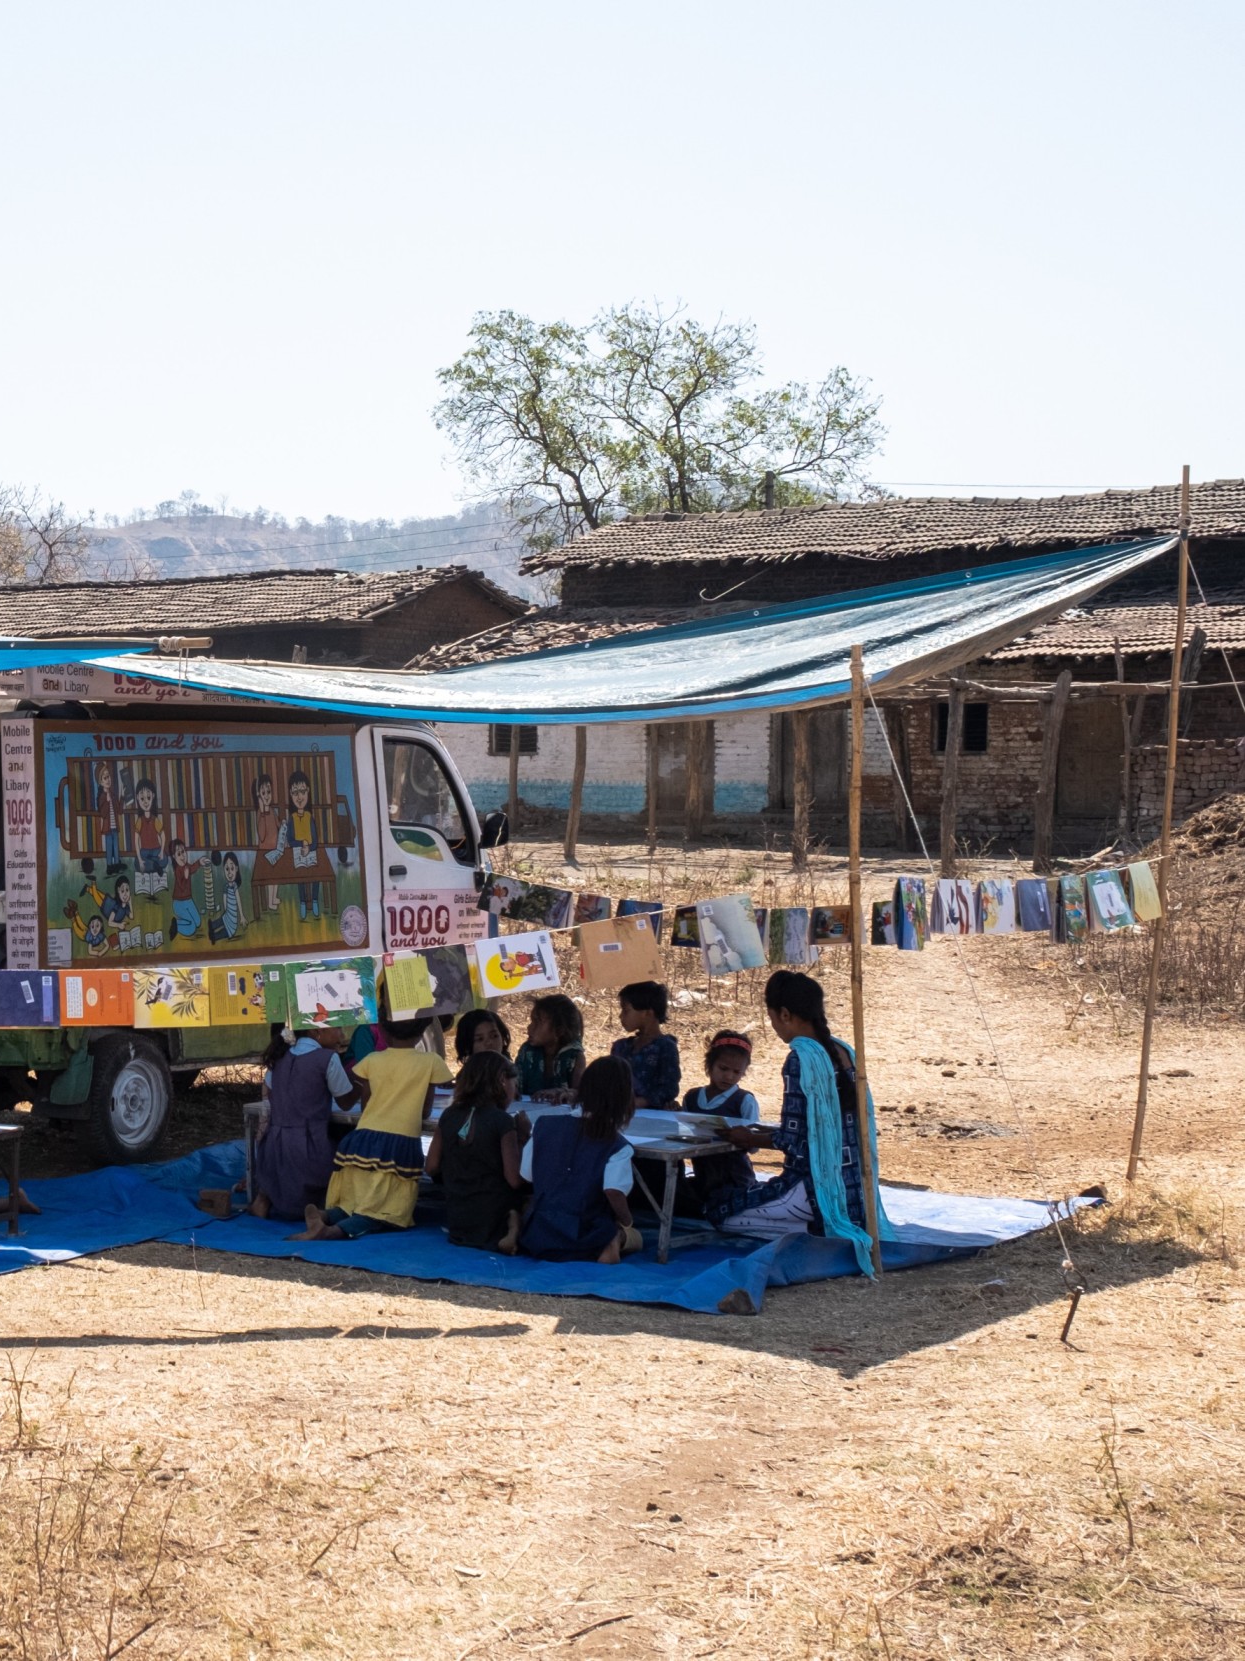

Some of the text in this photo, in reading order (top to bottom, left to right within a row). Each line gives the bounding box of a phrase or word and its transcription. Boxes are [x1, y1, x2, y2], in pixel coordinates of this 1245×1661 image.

[37, 664, 94, 677] Mobile Centre
[43, 678, 90, 695] and Libary
[114, 682, 152, 695] and
[3, 725, 30, 737] Mobile
[4, 743, 32, 755] Centre
[93, 734, 224, 752] 1000 and you
[8, 762, 24, 772] and
[5, 779, 30, 793] Libary
[5, 799, 33, 826] 1000
[13, 849, 27, 858] Girls
[7, 860, 35, 869] Education
[18, 872, 25, 880] on
[11, 882, 32, 891] Wheels
[386, 905, 450, 936] 1000
[390, 929, 447, 948] and you
